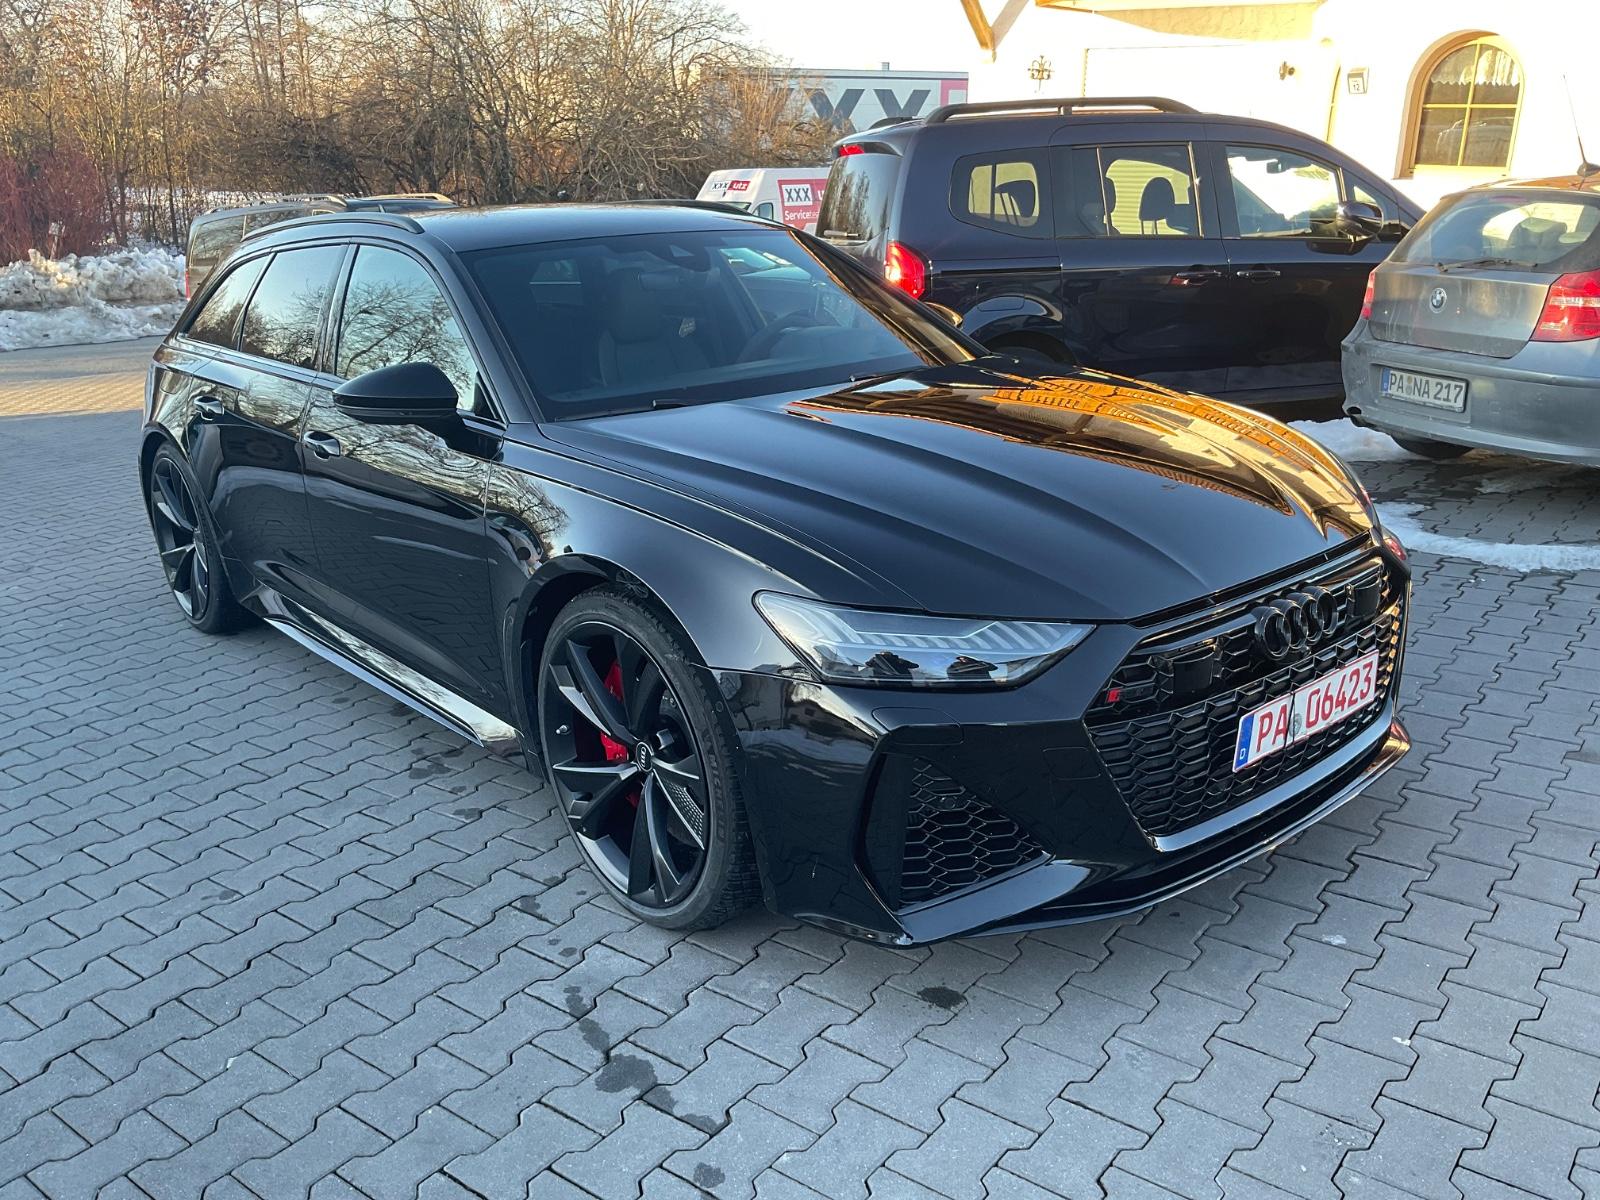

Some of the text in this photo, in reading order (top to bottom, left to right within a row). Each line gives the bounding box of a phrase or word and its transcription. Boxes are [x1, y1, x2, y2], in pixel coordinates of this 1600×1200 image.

[1389, 373, 1464, 404] PA NA 217
[1255, 660, 1373, 753] PA 06423
